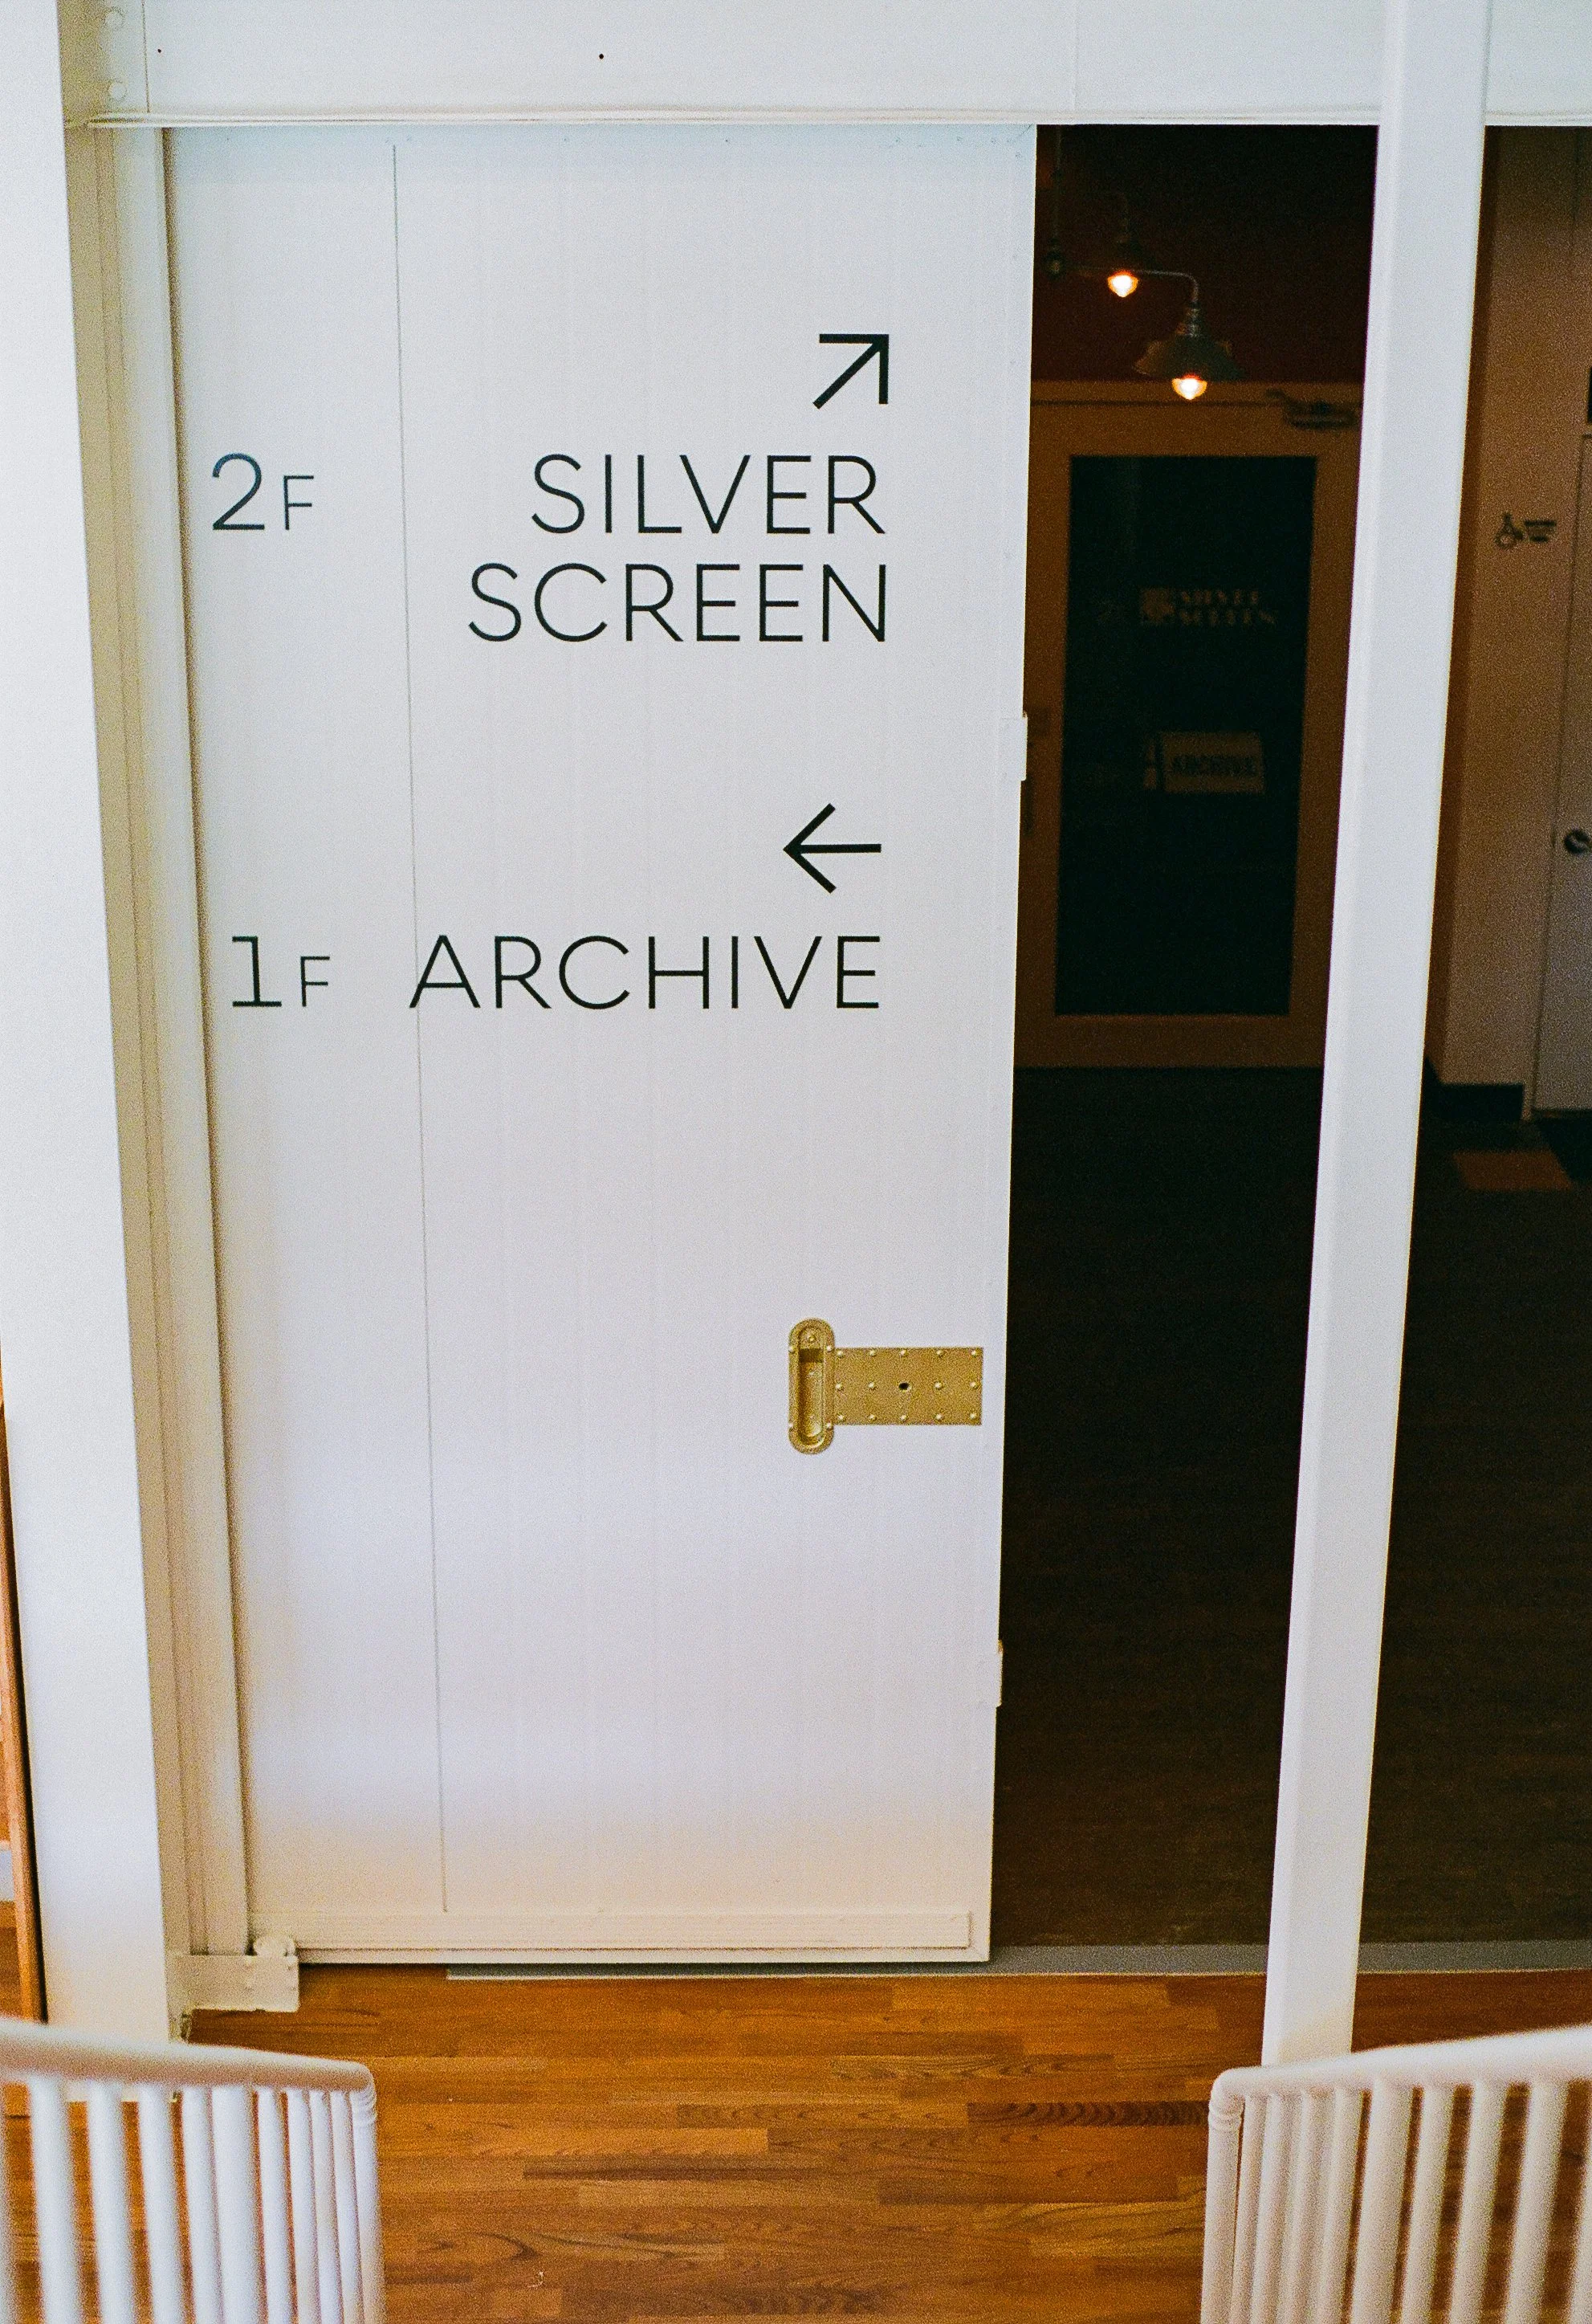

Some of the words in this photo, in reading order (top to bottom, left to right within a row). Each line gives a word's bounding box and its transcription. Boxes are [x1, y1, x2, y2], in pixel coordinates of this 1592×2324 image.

[212, 453, 315, 531] 2F
[531, 454, 886, 535] SILVER
[468, 562, 886, 642] SCREEN
[231, 936, 331, 1008] 1F
[409, 935, 881, 1010] ARCHIVE
